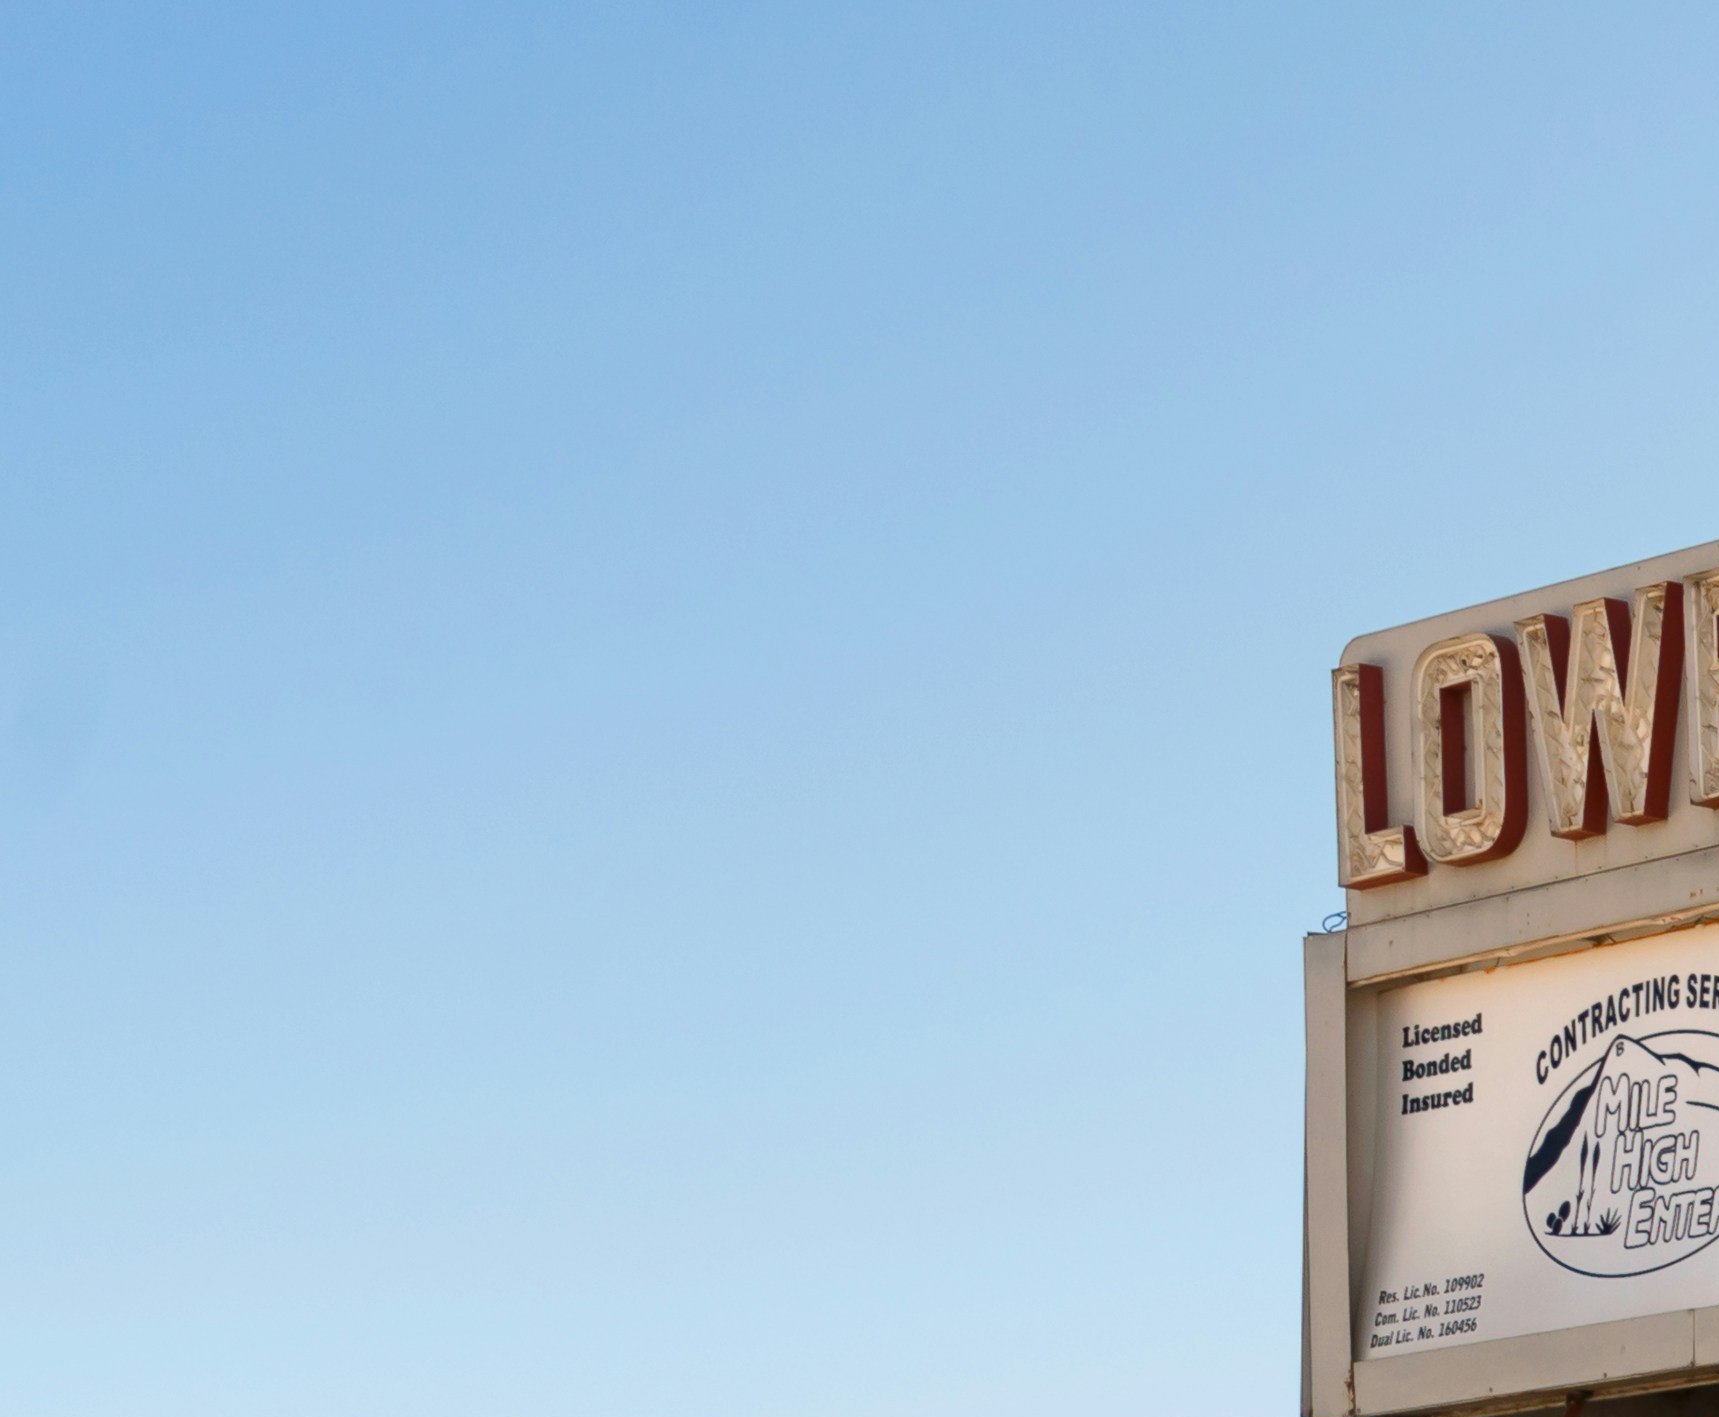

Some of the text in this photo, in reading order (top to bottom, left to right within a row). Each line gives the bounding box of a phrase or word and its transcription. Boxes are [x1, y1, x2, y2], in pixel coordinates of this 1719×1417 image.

[1402, 1013, 1483, 1048] Licensed
[1536, 974, 1680, 1084] CONTRACTING
[1402, 1049, 1472, 1081] Bonded
[1401, 1082, 1474, 1115] Insured
[1595, 1073, 1678, 1137] MILE
[1610, 1129, 1699, 1194] HIGH
[1379, 1290, 1400, 1305] Res.
[1424, 1304, 1440, 1318] No.
[1417, 1325, 1434, 1341] No.
